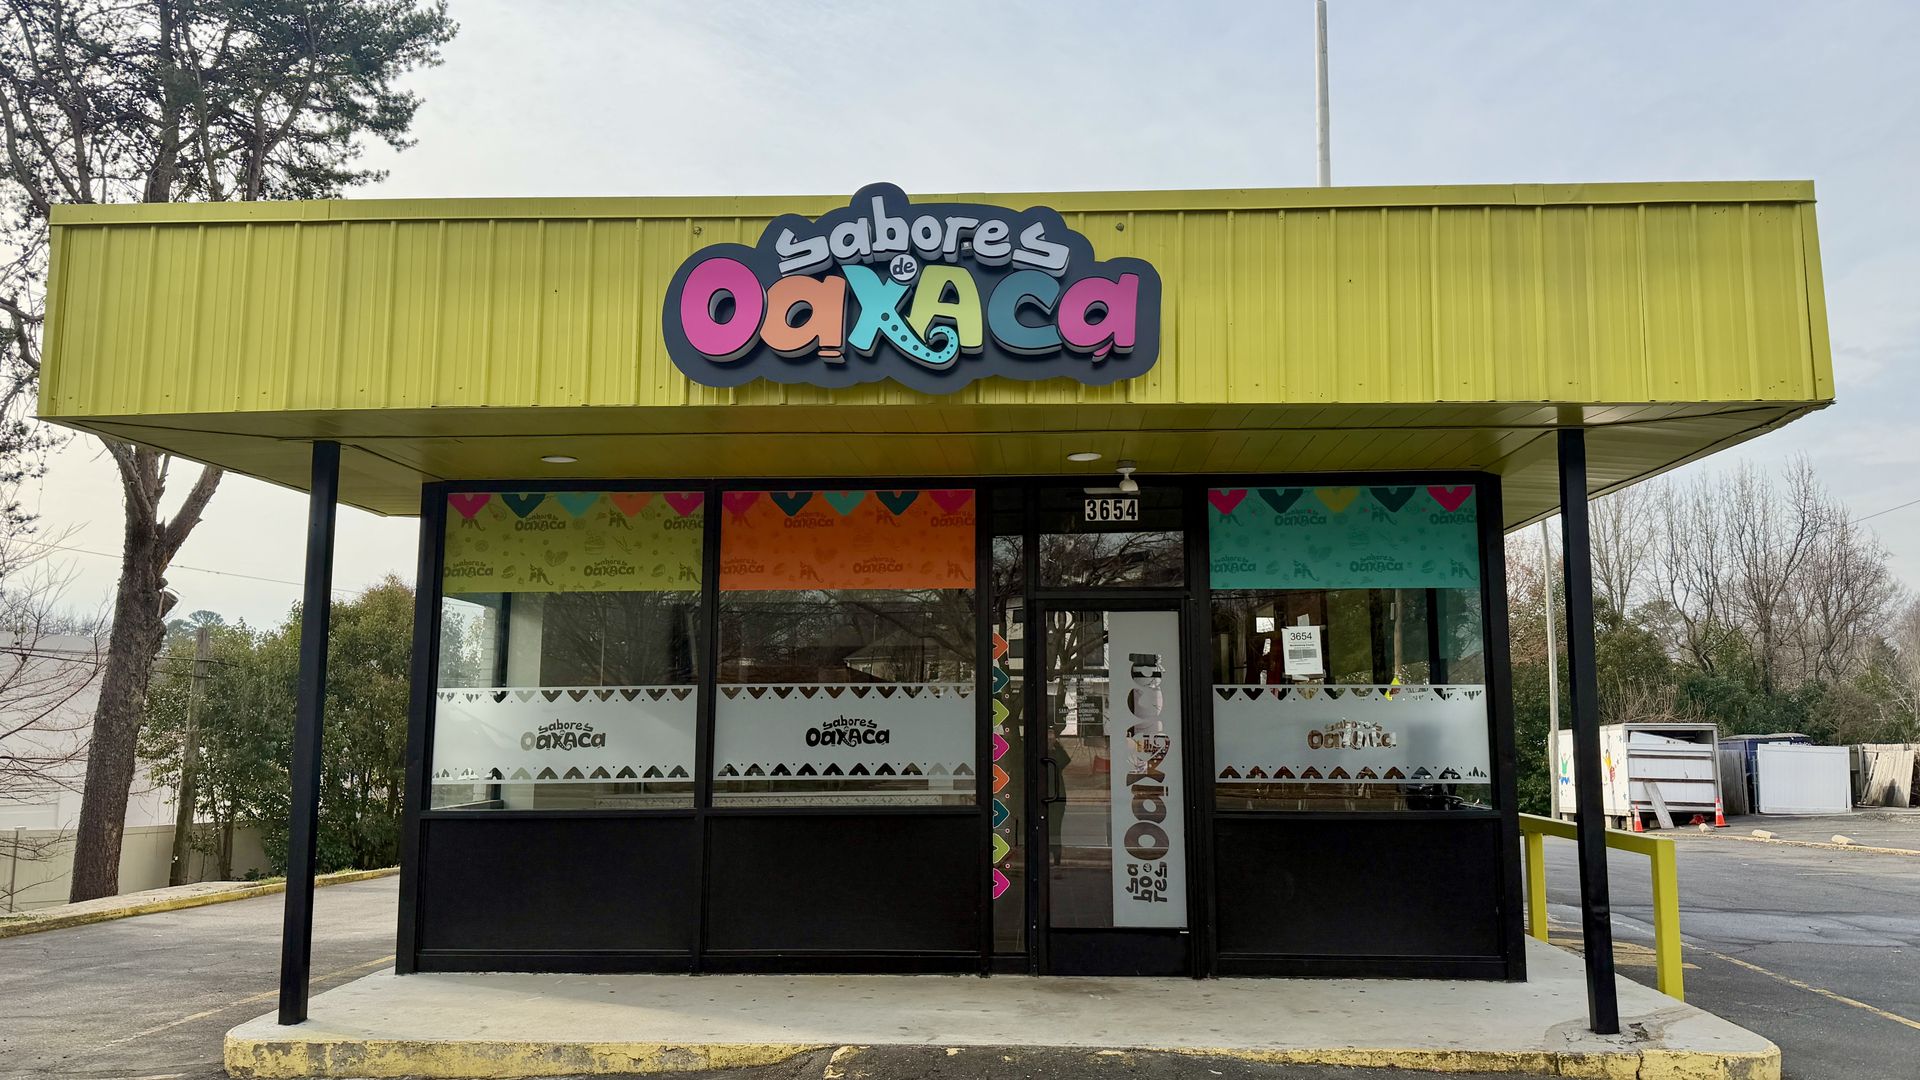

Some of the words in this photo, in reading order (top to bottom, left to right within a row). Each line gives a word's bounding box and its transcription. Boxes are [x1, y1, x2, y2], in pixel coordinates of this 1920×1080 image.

[891, 257, 915, 277] de
[1086, 500, 1137, 520] 3654
[1290, 632, 1312, 641] 3654
